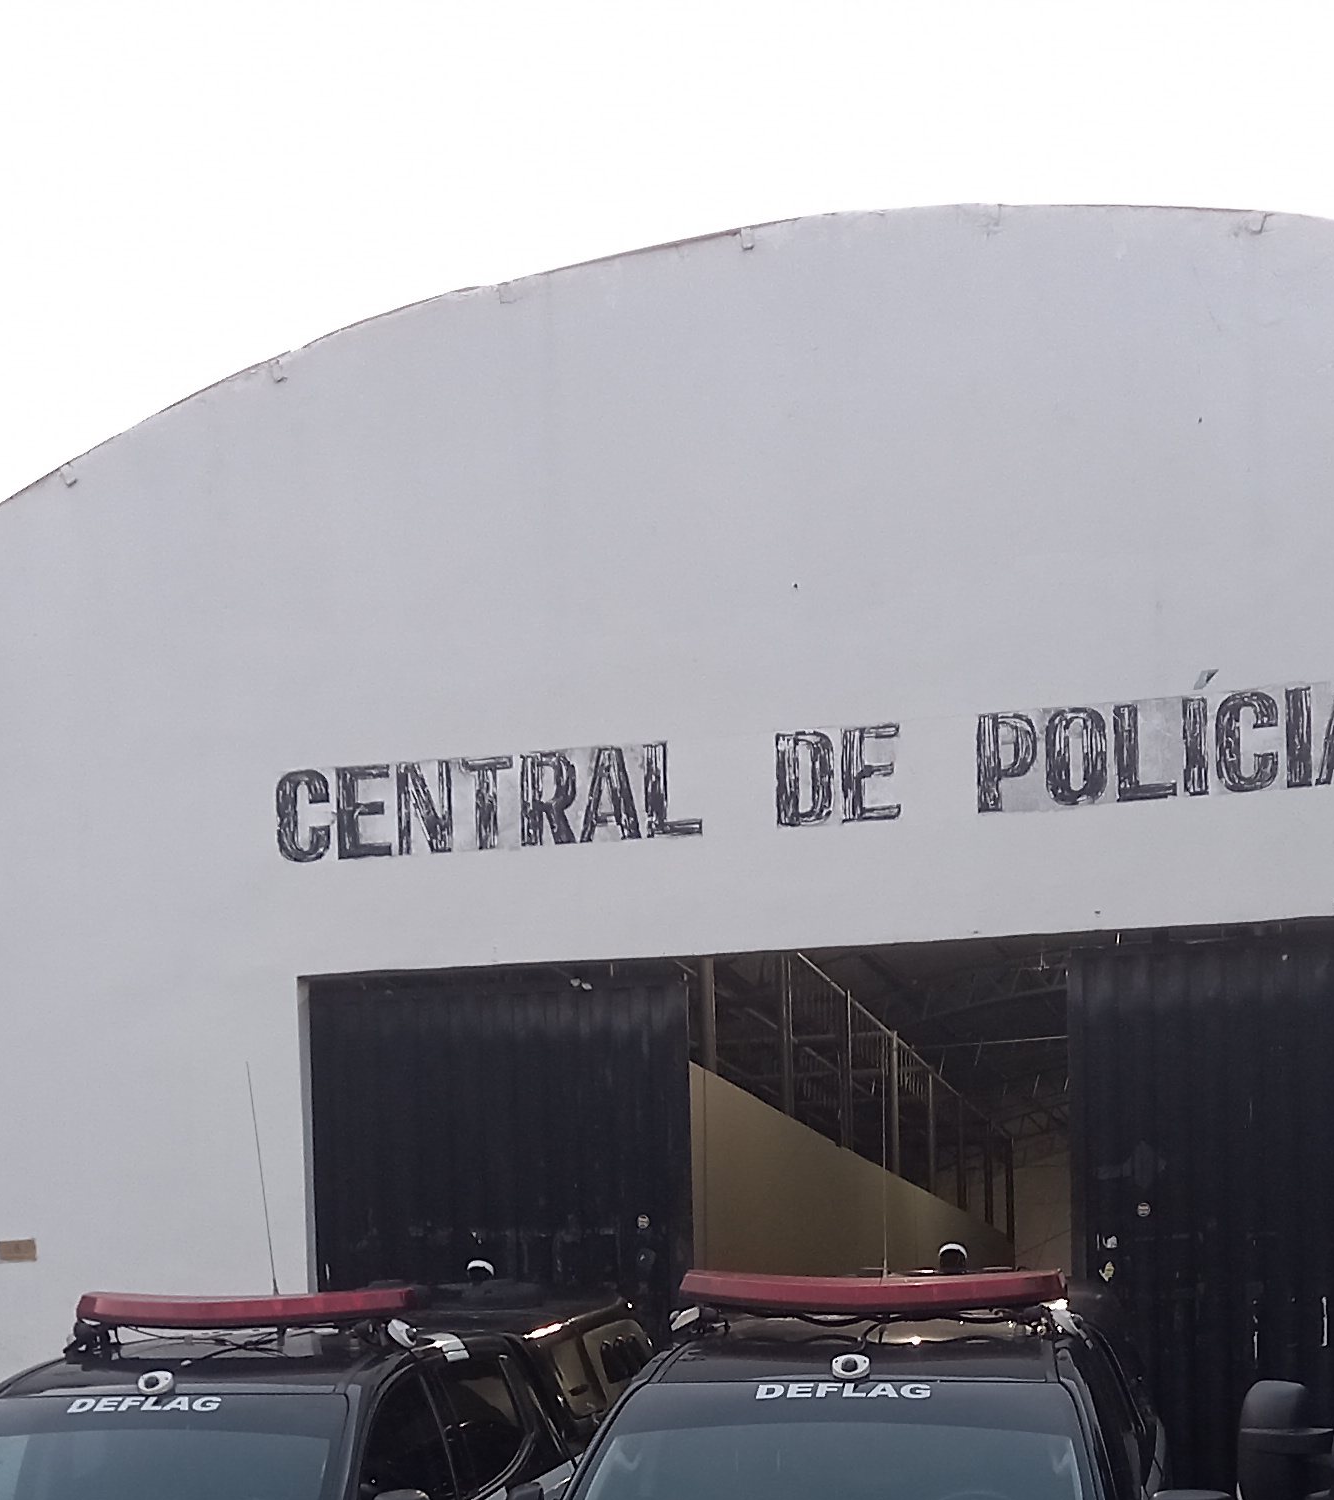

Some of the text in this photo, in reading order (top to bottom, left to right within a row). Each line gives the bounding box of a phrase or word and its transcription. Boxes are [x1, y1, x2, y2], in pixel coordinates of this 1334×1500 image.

[275, 741, 703, 864] CENTRAL
[774, 722, 900, 829] DE
[755, 1382, 931, 1400] DEFLAG
[66, 1396, 222, 1414] DEFLAG
